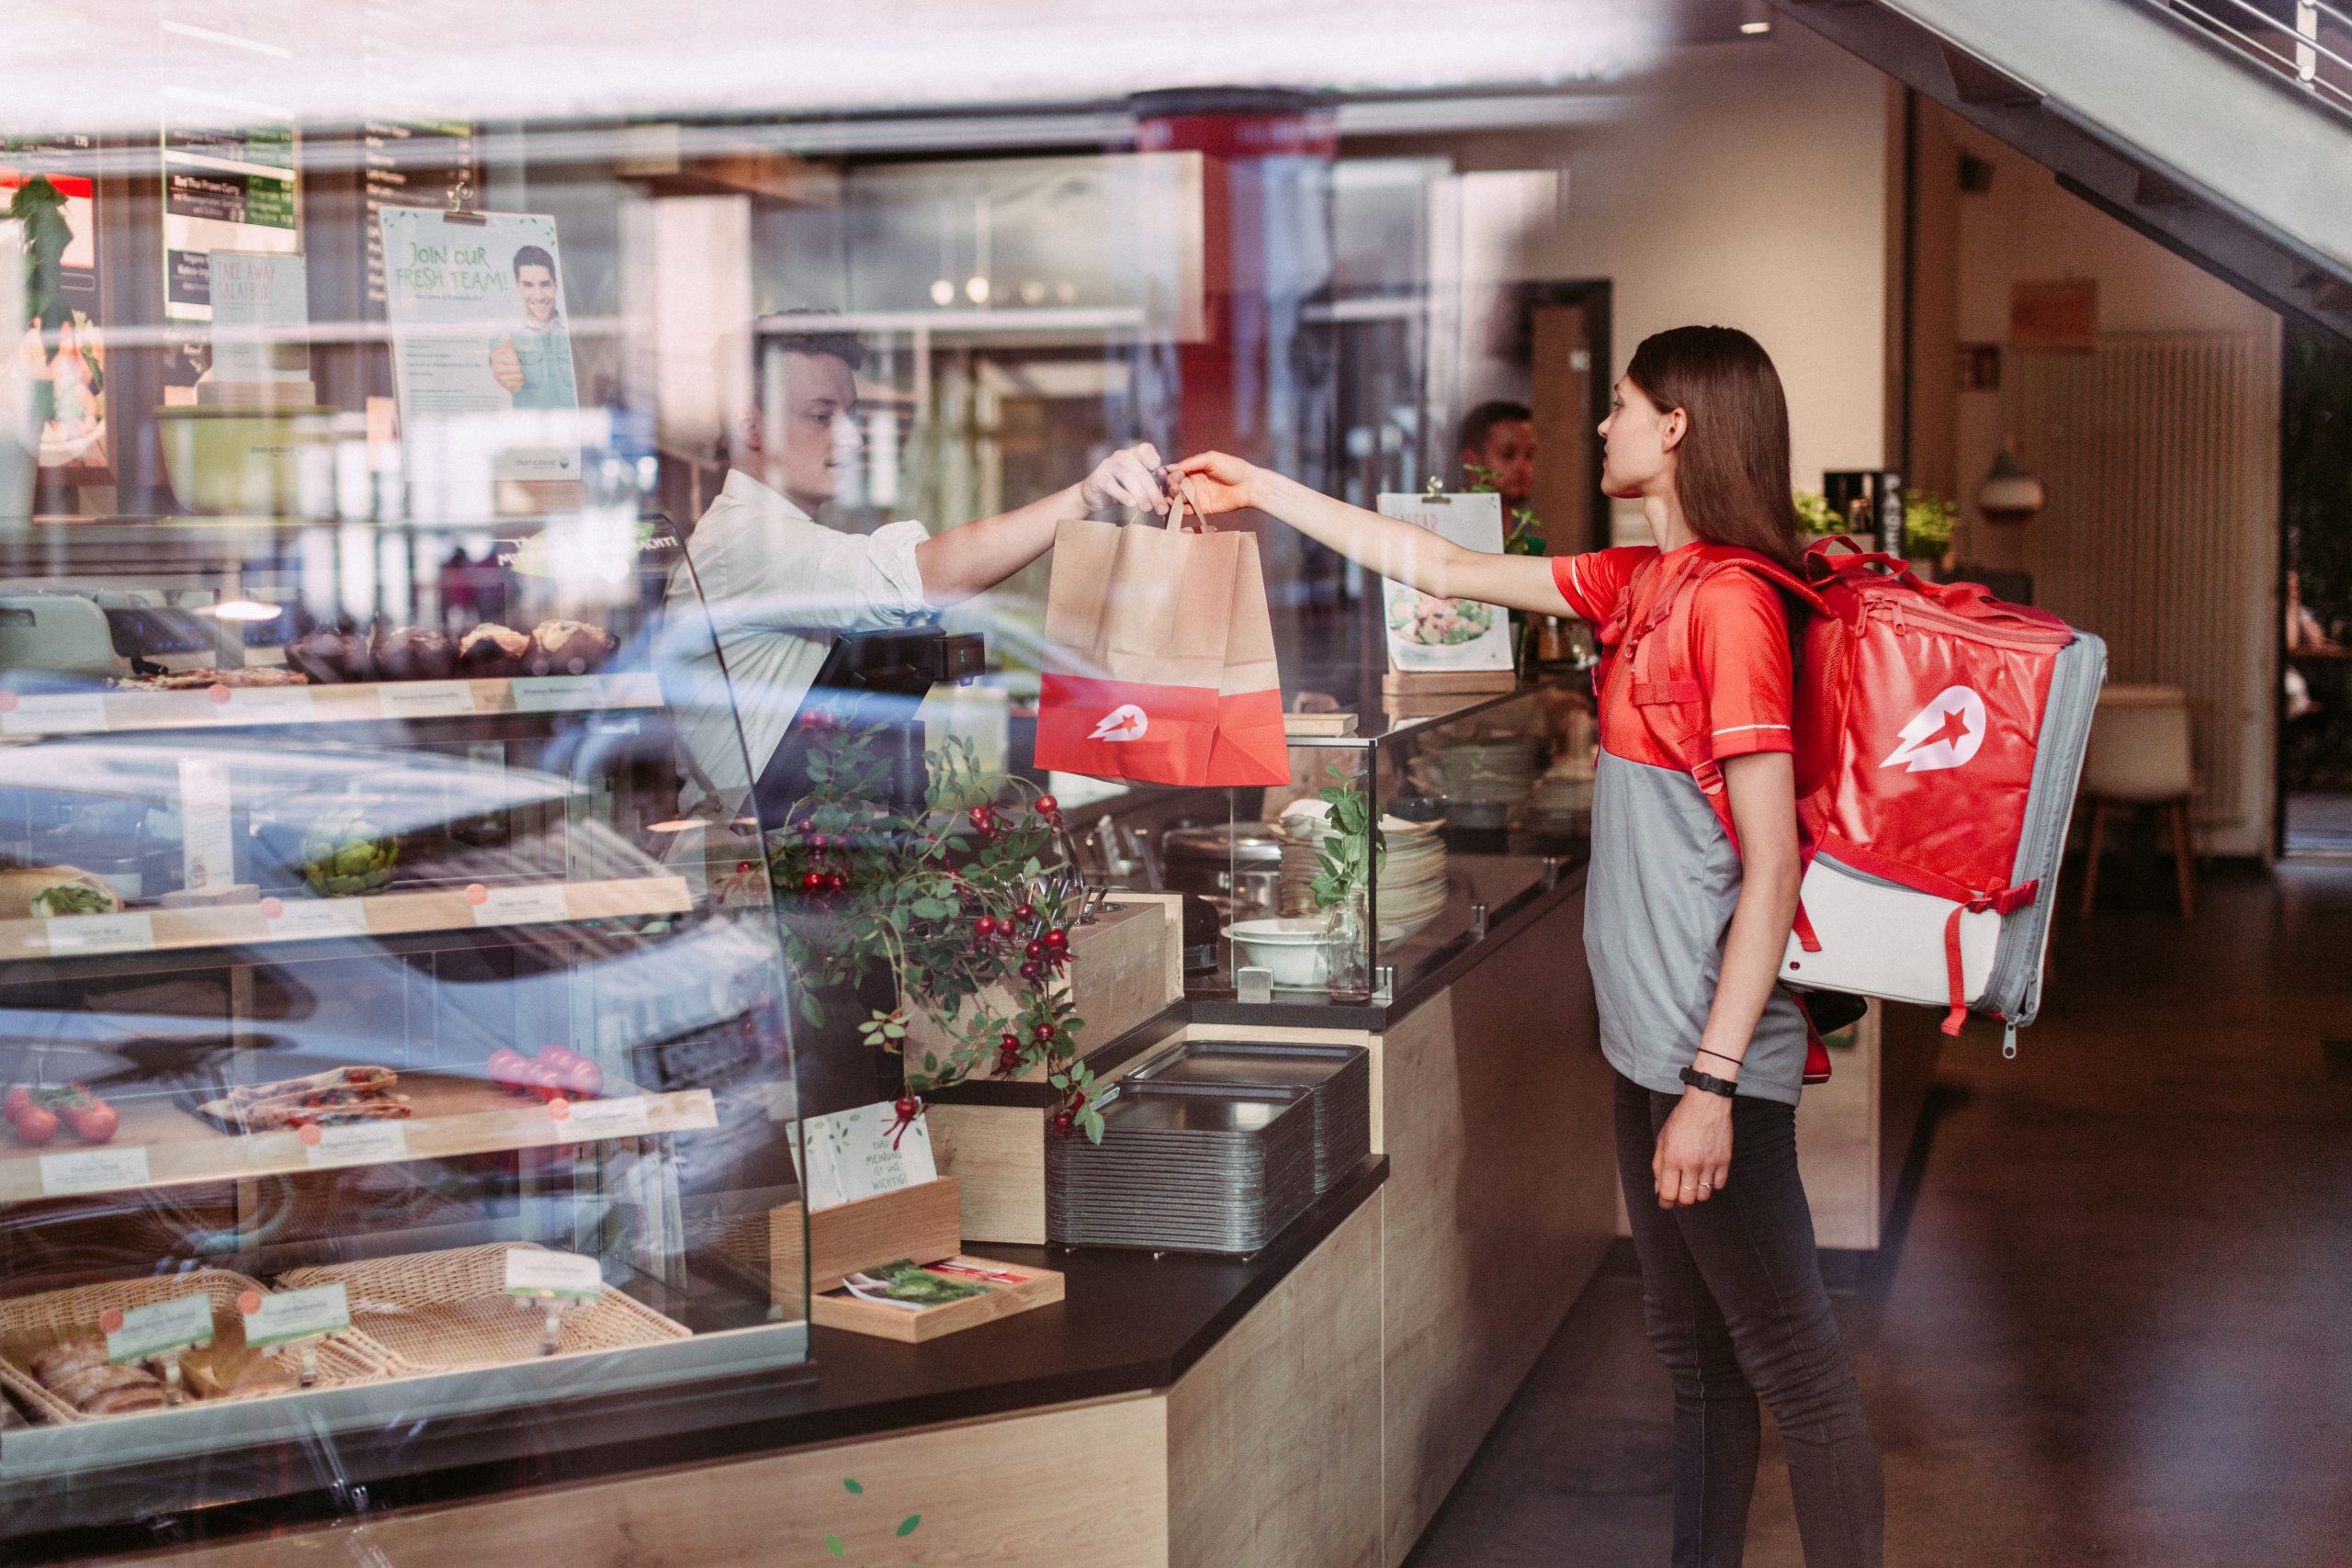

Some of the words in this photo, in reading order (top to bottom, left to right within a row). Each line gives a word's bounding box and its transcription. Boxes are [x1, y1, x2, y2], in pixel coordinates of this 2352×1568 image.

[409, 242, 447, 266] JOIN
[455, 246, 491, 269] OUR
[217, 262, 242, 280] TAKE
[248, 263, 276, 281] AWAY
[396, 266, 444, 289] FRESH
[449, 270, 508, 291] TEAM!
[217, 281, 270, 300] SALATBOX
[866, 1150, 903, 1166] MEINUNG
